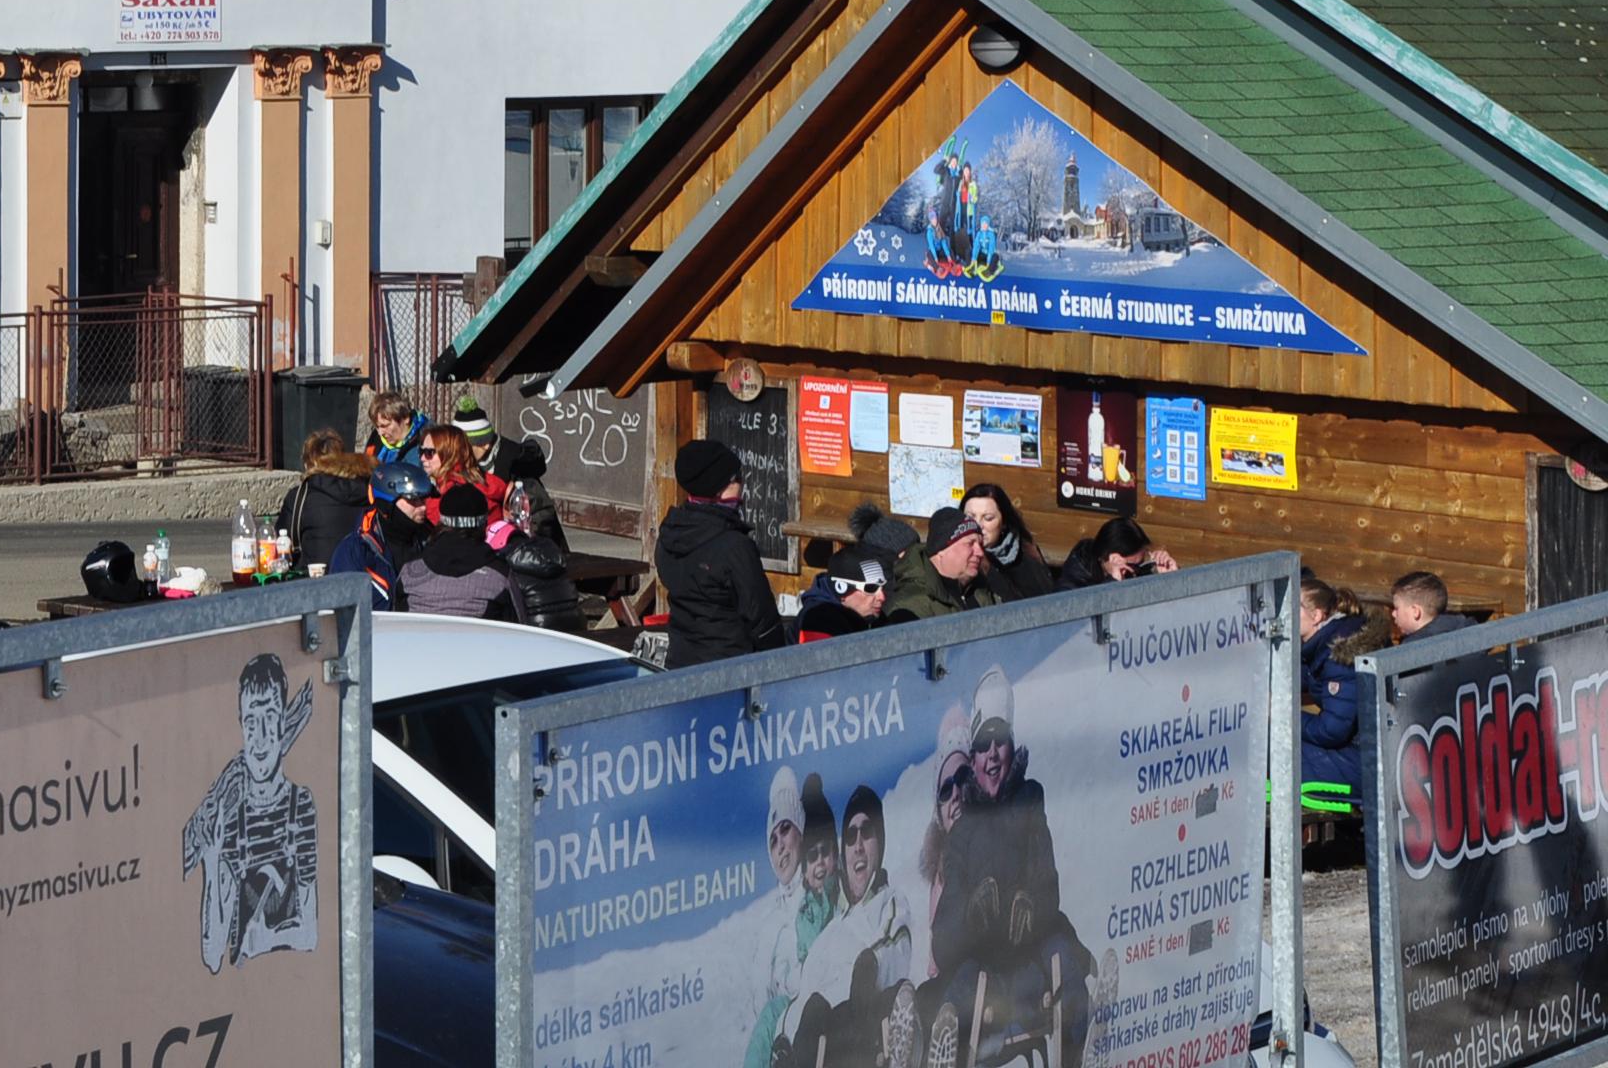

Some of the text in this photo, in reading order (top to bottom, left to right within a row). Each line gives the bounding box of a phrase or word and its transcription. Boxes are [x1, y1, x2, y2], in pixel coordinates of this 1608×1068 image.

[137, 8, 217, 20] UBYTOVÁNÍ
[822, 272, 892, 302] PŘÍRODNÍ
[895, 277, 988, 310] SÁŇKAŘSKÁ
[991, 285, 1039, 315] DRÁHA
[1059, 289, 1114, 320] ČERNÁ
[1117, 301, 1195, 327] STUDNICE
[1215, 304, 1307, 336] SMRŽOVKA
[1108, 619, 1212, 673] PŮJČOVNY
[534, 675, 905, 816] PŘÍRODNÍ SÁŇKAŘSKÁ
[1120, 702, 1248, 758] SKIAREÁL FILIP
[1137, 745, 1230, 795] SMRŽOVKA
[1130, 795, 1160, 825] SANĚ
[1163, 798, 1168, 816] 1
[1170, 795, 1190, 814] den
[1221, 780, 1235, 801] Kč
[534, 812, 656, 891] DRÁHA
[1131, 839, 1231, 894] ROZHLEDNA
[534, 860, 756, 952] NATURRODELBAHN
[1107, 872, 1250, 940] ČERNÁ STUDNICE
[1404, 870, 1608, 969] samolepící písmo na výlohy pole
[1125, 934, 1155, 965] SANĚ
[1158, 937, 1163, 954] 1
[1166, 932, 1184, 952] den
[1217, 916, 1230, 937] Kč
[1407, 966, 1459, 1013] reklamní
[1461, 953, 1500, 1000] panely
[1508, 927, 1563, 980] sportovní
[1565, 923, 1595, 952] dresy
[1597, 920, 1604, 942] s
[535, 967, 705, 1049] délka sáňkařské
[1094, 952, 1255, 1025] dopravu na start přírodní
[1093, 986, 1254, 1057] sáňkařské dráhy zajišťuje
[1179, 1038, 1201, 1068] 602
[1205, 1029, 1228, 1064] 286
[622, 1041, 652, 1068] km
